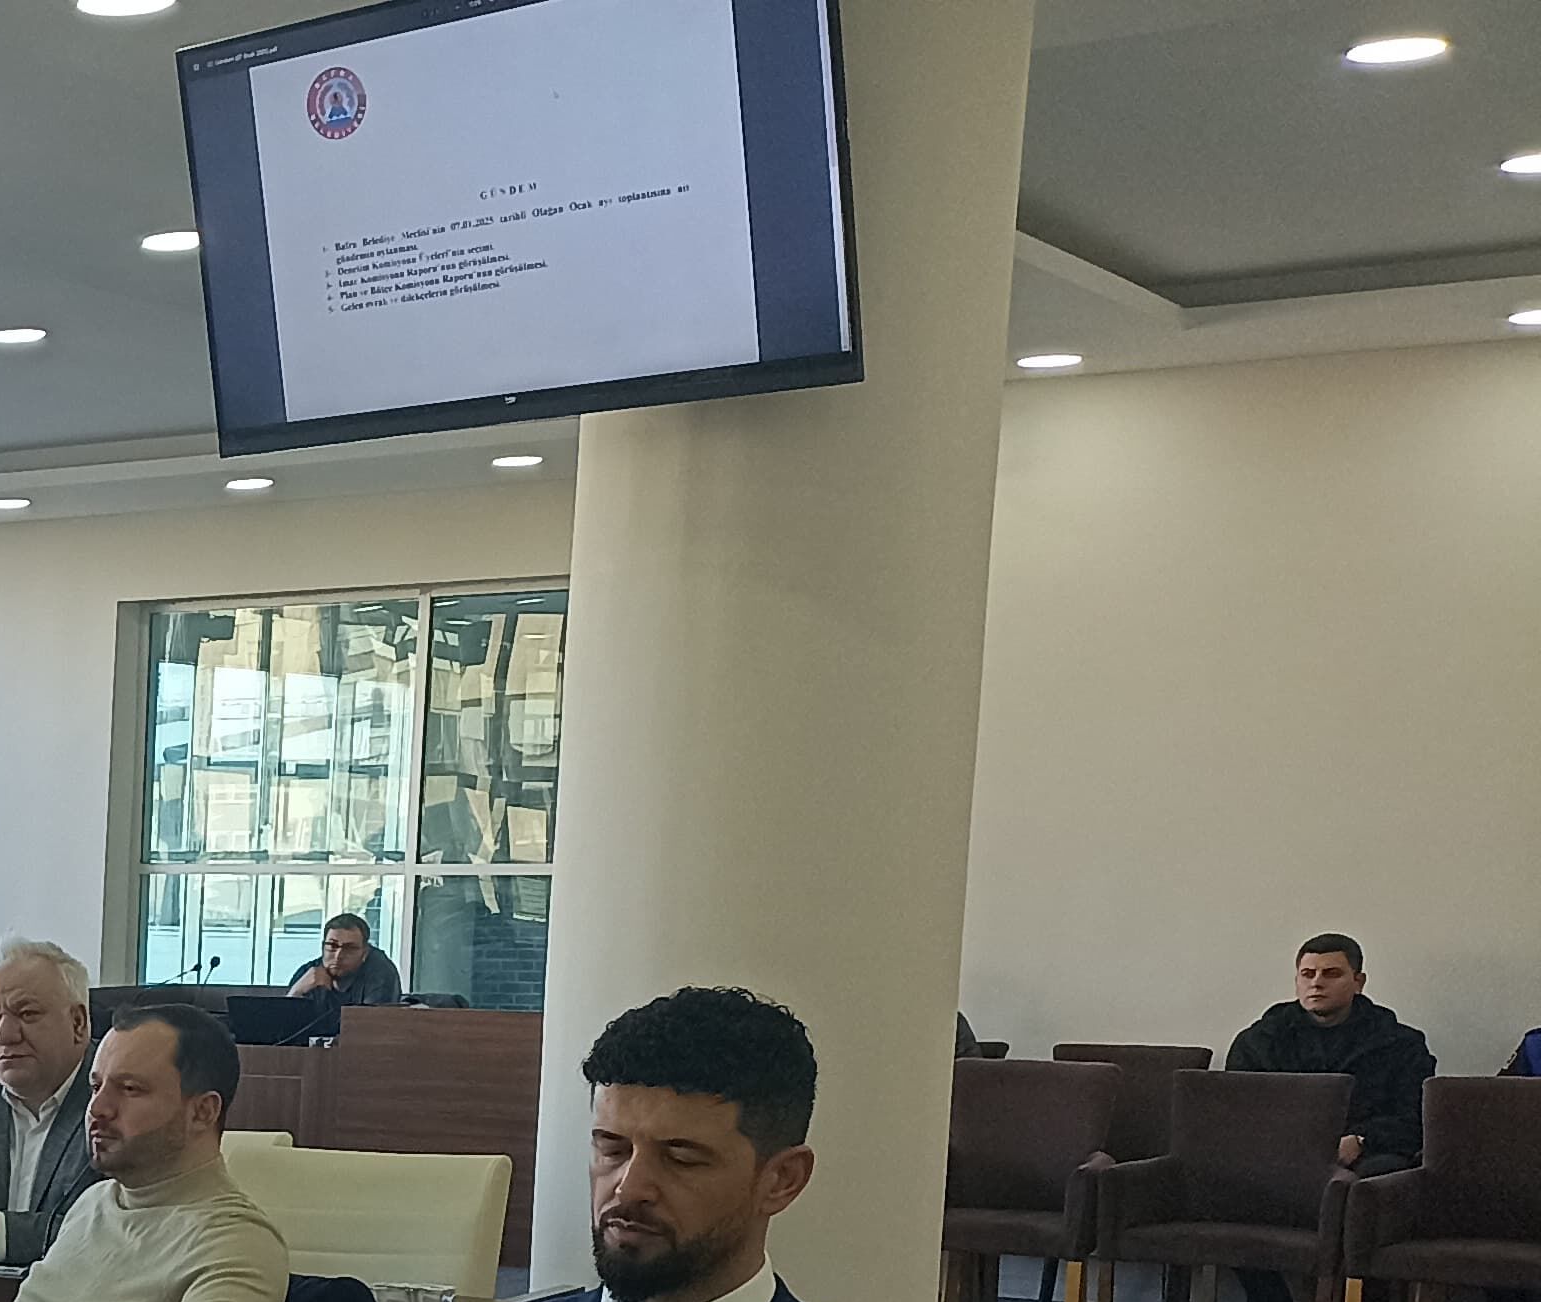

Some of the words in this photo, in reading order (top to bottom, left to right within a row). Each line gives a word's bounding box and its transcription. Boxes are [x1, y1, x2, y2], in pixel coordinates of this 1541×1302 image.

[335, 241, 357, 252] Bafra
[362, 235, 395, 247] Belediye
[499, 210, 527, 223] tarihli
[531, 206, 564, 218] Olağan
[569, 200, 593, 211] Ocak
[341, 301, 364, 312] Gelen
